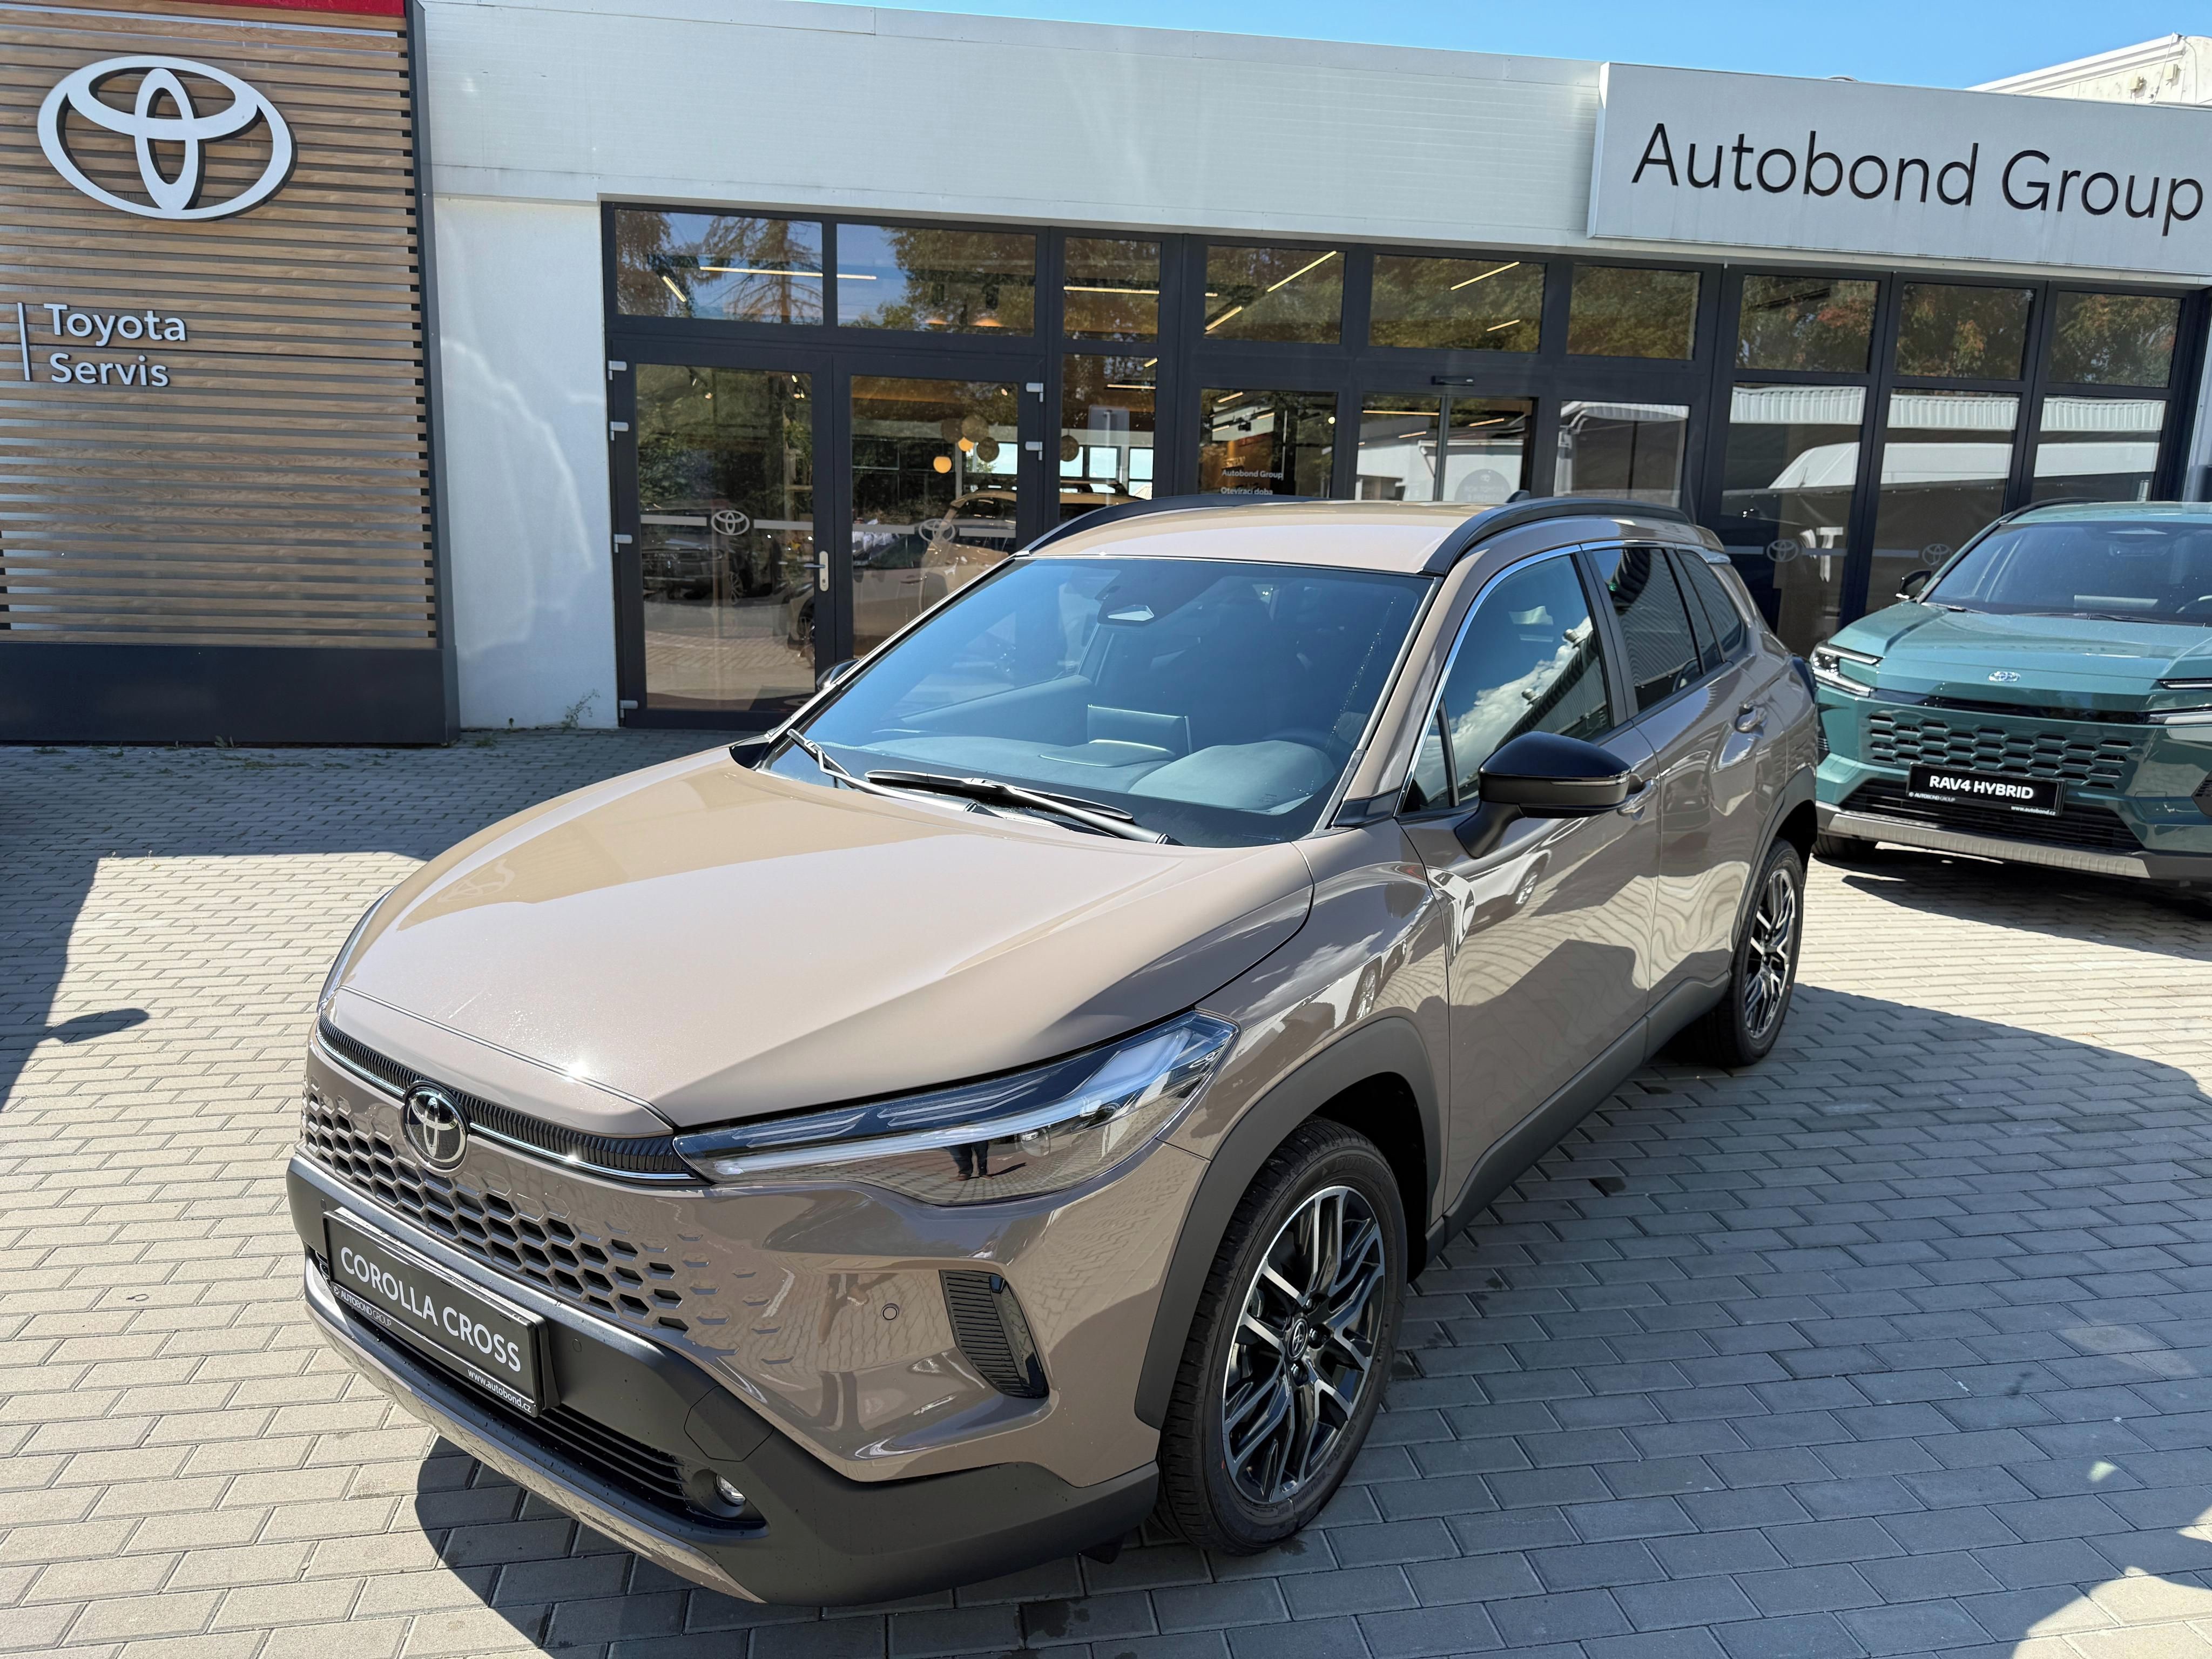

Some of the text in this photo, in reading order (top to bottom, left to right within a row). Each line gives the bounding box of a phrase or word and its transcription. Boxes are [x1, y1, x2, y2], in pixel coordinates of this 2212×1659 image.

[1631, 123, 2204, 237] Autobond Group
[43, 302, 187, 347] Toyota
[50, 352, 170, 387] Servis
[1222, 469, 1284, 480] Autobond Group
[1914, 792, 1940, 801] AUTOBOND
[1929, 775, 2034, 799] RAV4 HYBRID
[2011, 806, 2056, 816] www.autobond.cz
[341, 1290, 392, 1326] AUTOBOND GROUP
[341, 1247, 521, 1372] COROLLA CROSS
[468, 1369, 531, 1413] www.autobond.cz
